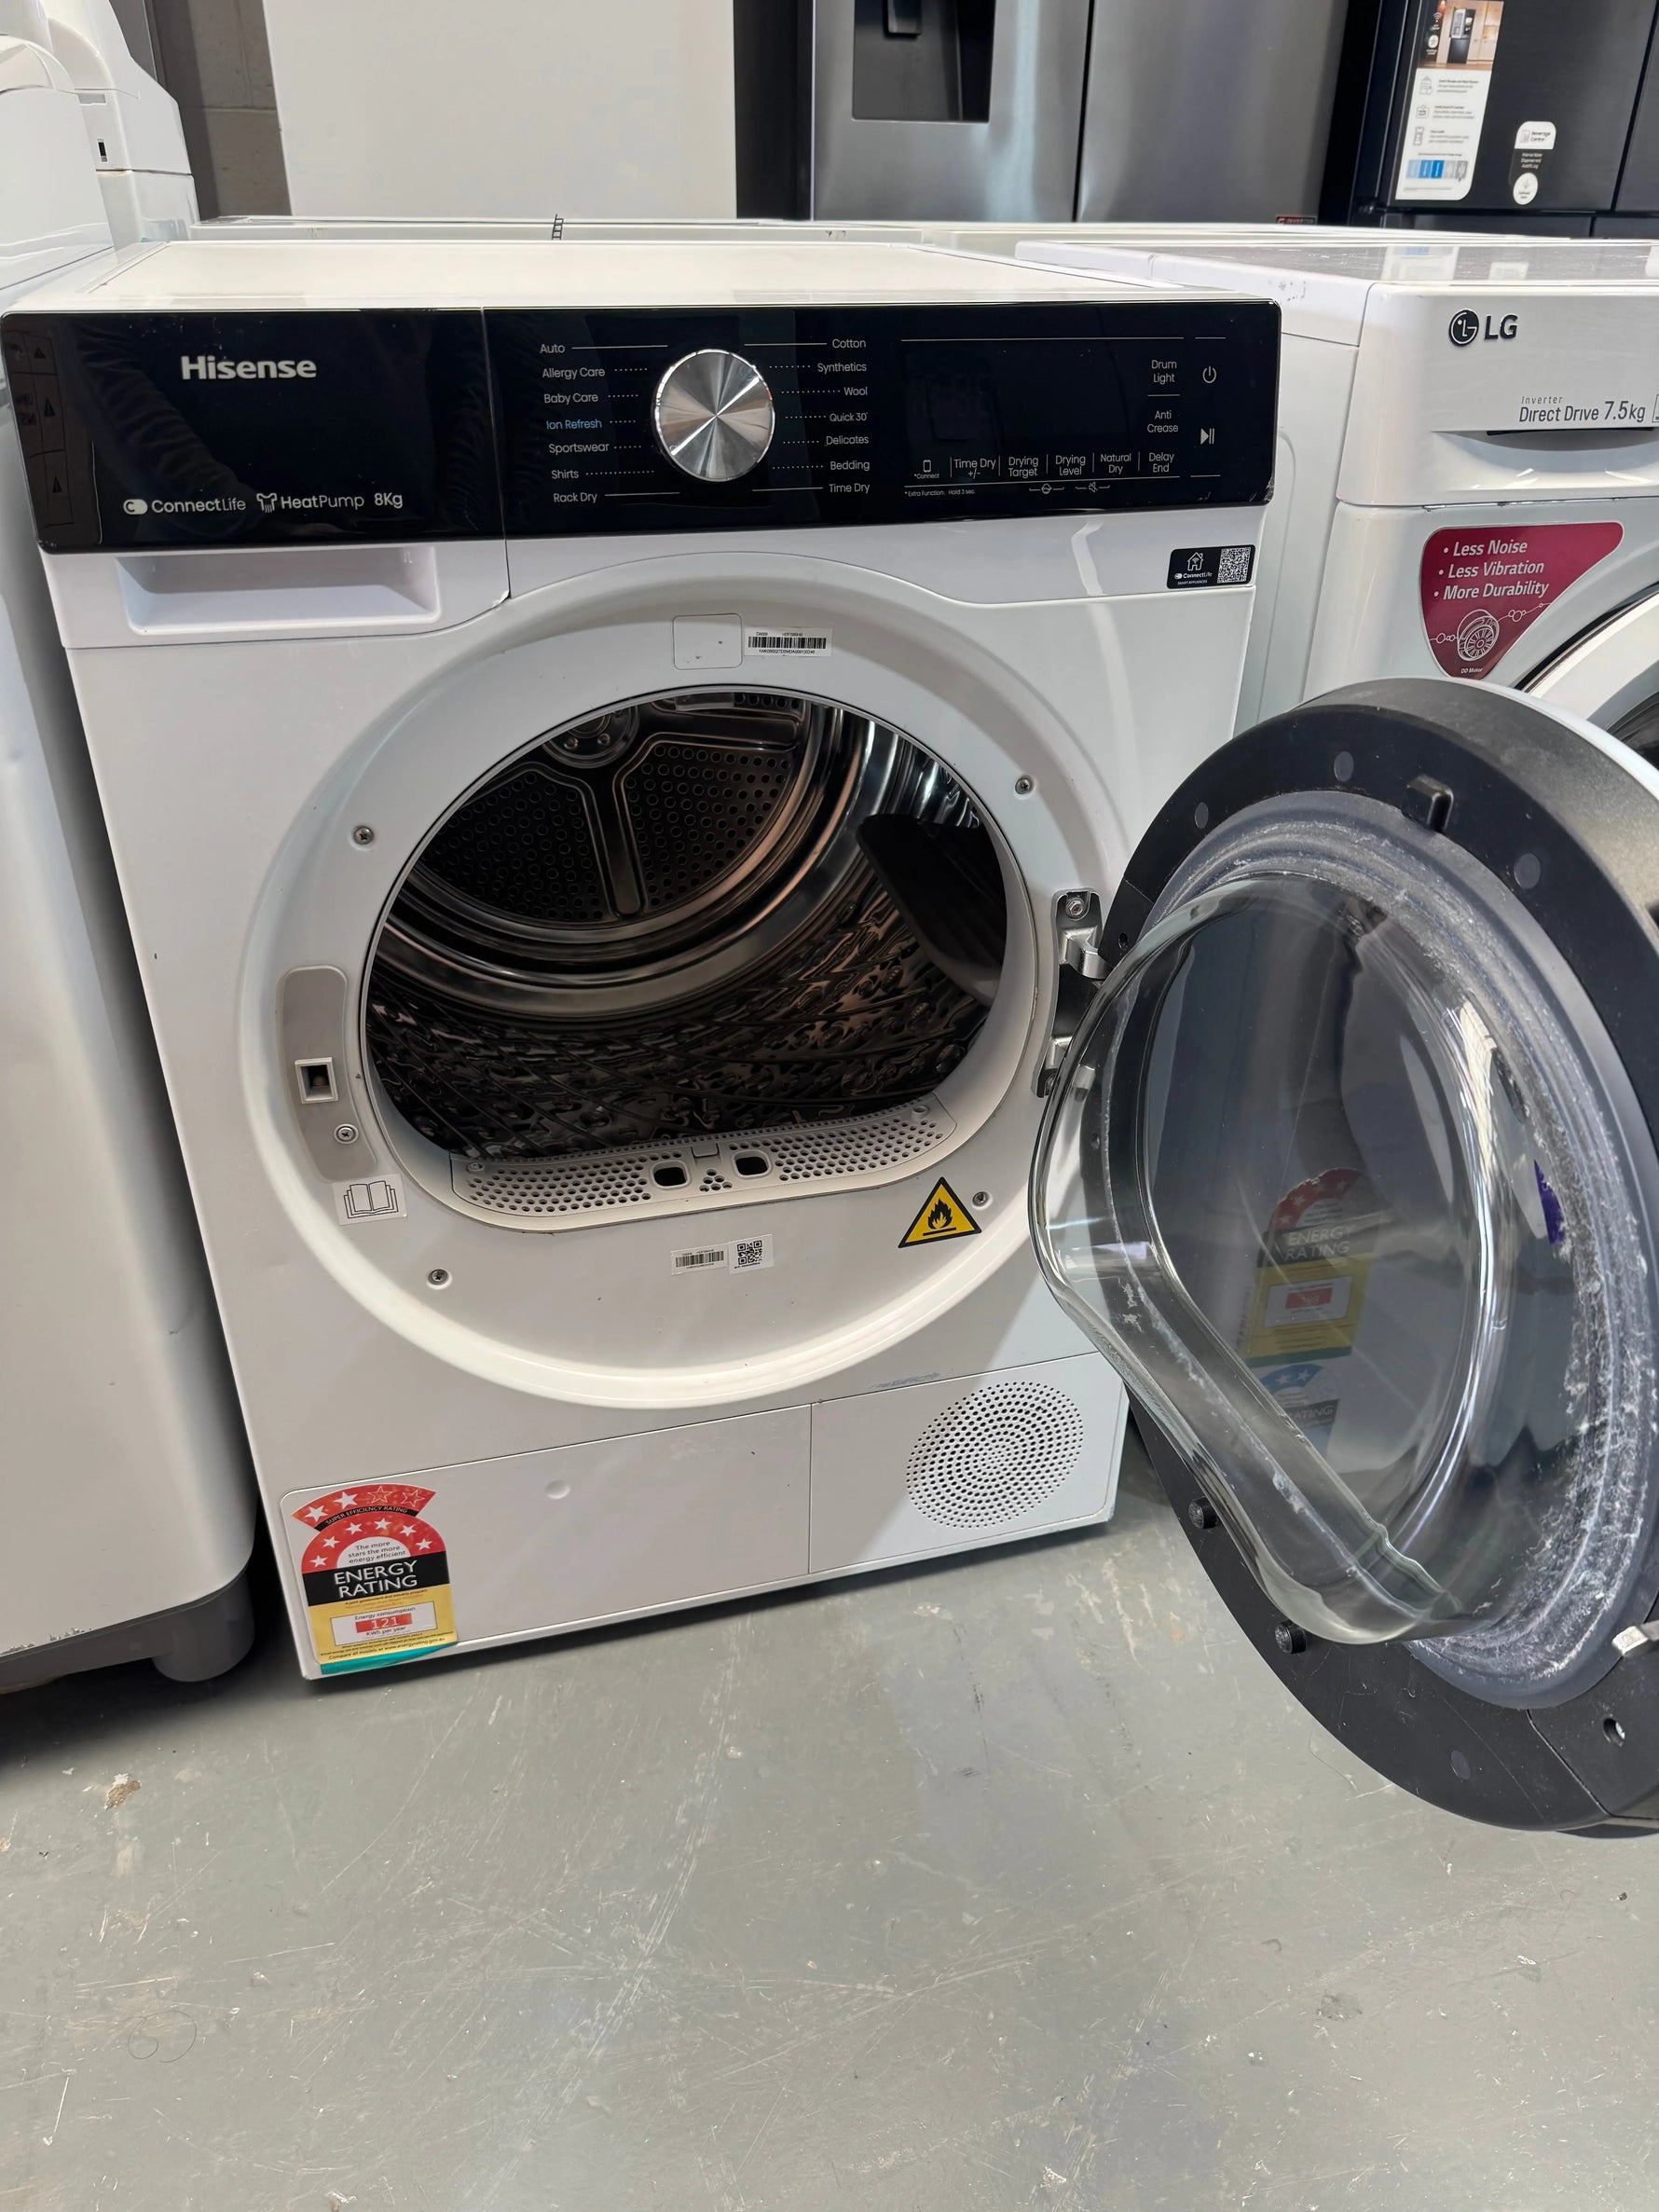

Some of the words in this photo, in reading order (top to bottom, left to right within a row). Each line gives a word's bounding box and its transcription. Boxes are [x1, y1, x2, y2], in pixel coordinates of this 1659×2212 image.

[1484, 313, 1518, 340] LG
[540, 343, 566, 354] Auto
[831, 338, 867, 349] Cotton
[181, 356, 317, 380] Hisense
[817, 362, 867, 374] Synthetics
[1151, 359, 1178, 369] Drum
[542, 367, 578, 379] Allergy
[580, 367, 606, 378] Care
[1153, 373, 1175, 385] Light
[843, 387, 868, 396] Wool
[543, 393, 569, 405] Baby
[572, 392, 598, 403] Care
[1521, 395, 1564, 405] Inverter
[830, 412, 854, 422] Quick
[1155, 409, 1172, 420] Anti
[1519, 405, 1560, 423] Direct
[1563, 405, 1599, 422] Drive
[546, 419, 562, 430] Ion
[565, 419, 602, 430] Refresh
[1147, 423, 1179, 433] Crease
[826, 434, 870, 446] Delicates
[548, 442, 610, 455] Sportswear
[1008, 456, 1038, 468] Drying
[1055, 454, 1086, 467] Drying
[1100, 452, 1131, 462] Natural
[1148, 451, 1174, 464] Delay
[830, 460, 871, 472] Bedding
[953, 459, 978, 468] Time
[980, 458, 996, 470] Dry
[1108, 463, 1123, 475] Dry
[1152, 462, 1170, 473] End
[552, 469, 579, 479] Shirts
[1008, 467, 1038, 478] Target
[1059, 465, 1082, 476] Level
[829, 483, 851, 493] Time
[853, 482, 871, 494] Dry
[281, 493, 364, 513] HeatPump
[374, 492, 404, 510] 8Kg
[554, 492, 578, 503] Rack
[581, 492, 597, 504] Dry
[151, 497, 246, 514] ConnectLife
[1453, 541, 1484, 556] Less
[1488, 540, 1528, 556] Noise
[1448, 562, 1479, 579] Less
[1483, 560, 1544, 577] Vibration
[1443, 584, 1482, 600] More
[1483, 582, 1549, 598] Durability
[325, 1513, 346, 1525] SUPER
[346, 1506, 382, 1517] EFFICIENCY
[349, 1555, 375, 1564] energy
[377, 1551, 406, 1559] efficient
[334, 1560, 418, 1585] ENERGY
[338, 1575, 418, 1599] RATING
[377, 1607, 416, 1617] consumption
[371, 1616, 400, 1629] 121
